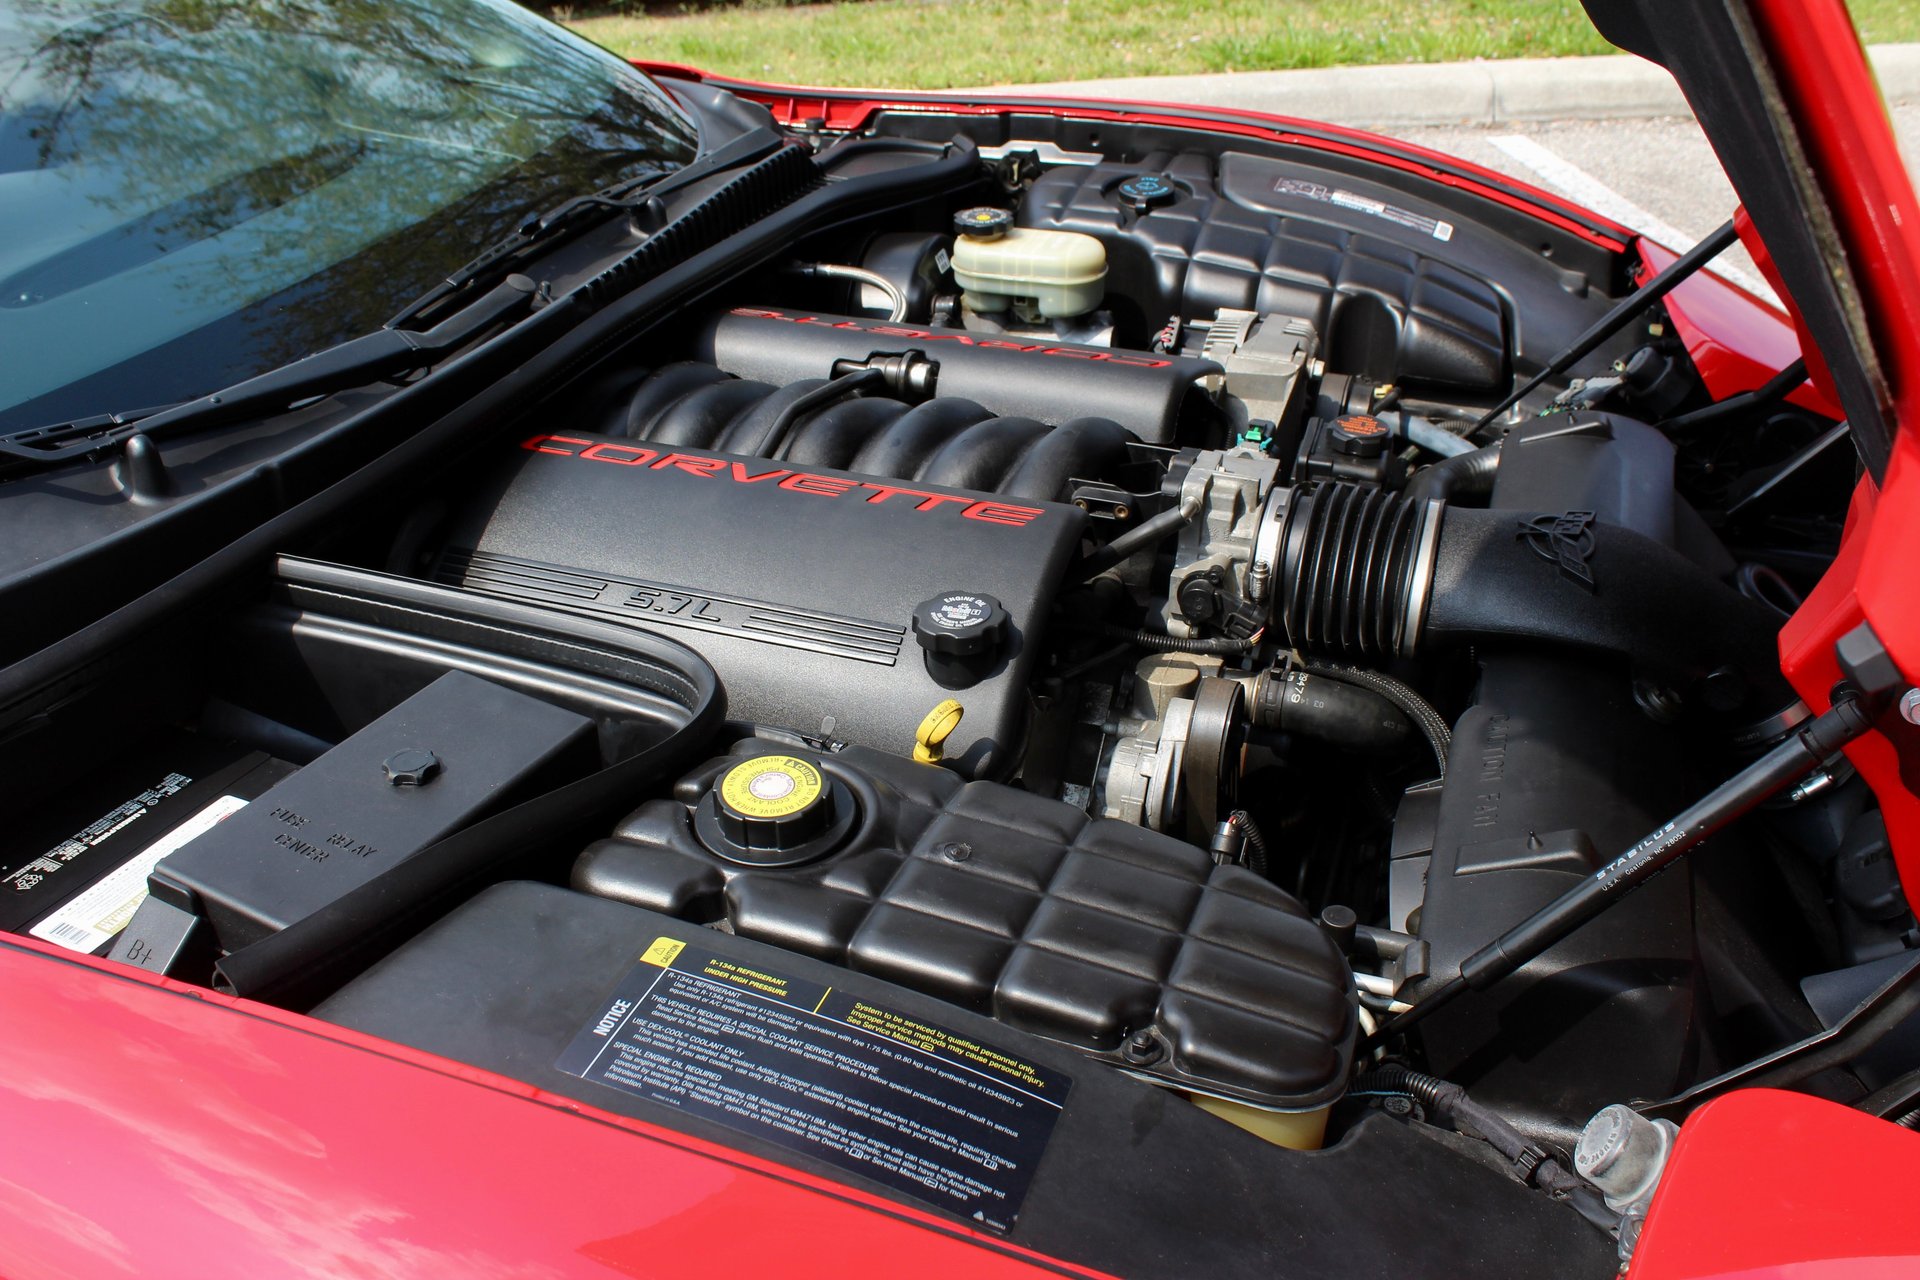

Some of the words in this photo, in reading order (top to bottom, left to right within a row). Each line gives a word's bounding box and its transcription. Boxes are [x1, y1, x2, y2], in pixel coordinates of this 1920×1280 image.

[520, 434, 1046, 526] CORVETTE
[623, 588, 721, 622] 5.7L
[795, 763, 817, 785] CAUTION
[270, 807, 311, 830] FUSE
[326, 833, 377, 858] RELAY
[274, 834, 329, 863] CENTER
[1596, 822, 1675, 880] STABILUS
[1601, 876, 1621, 892] U.S.A.
[1625, 855, 1654, 876] Gastonia,
[1654, 846, 1665, 856] NC
[1665, 830, 1687, 848] 28052
[127, 939, 152, 965] B+
[661, 944, 680, 964] CAUTION
[667, 972, 694, 984] R-134a
[693, 980, 742, 998] REFRIGERANT
[704, 967, 730, 979] UNDER
[729, 974, 749, 985] HIGH
[748, 980, 787, 997] PRESSURE
[709, 959, 736, 971] R-134a
[736, 967, 787, 986] REFRIGERANT
[593, 998, 632, 1037] NOTICE
[651, 1010, 678, 1022] damage
[685, 1020, 697, 1028] the
[669, 987, 702, 1001] equivalent
[708, 999, 722, 1007] A/C
[721, 1003, 745, 1014] system
[632, 1017, 648, 1027] USE
[689, 1035, 725, 1051] COOLANT
[724, 1046, 745, 1057] ONLY
[651, 994, 668, 1004] THIS
[667, 999, 697, 1013] VEHICLE
[696, 1008, 732, 1024] REQUIRES
[738, 1021, 767, 1036] SPECIAL
[769, 1031, 804, 1047] COOLANT
[803, 1043, 835, 1058] SERVICE
[835, 1053, 879, 1074] PROCEDURE
[673, 981, 686, 989] Use
[686, 985, 701, 994] only
[700, 989, 724, 1001] R-134a
[724, 997, 758, 1011] refrigerant
[803, 1022, 837, 1037] equivalent
[837, 1034, 852, 1042] with
[852, 1039, 865, 1047] dye
[924, 1065, 938, 1074] and
[937, 1070, 967, 1085] synthetic
[846, 1016, 862, 1026] See
[862, 1021, 891, 1036] Service
[891, 1031, 920, 1046] Manual
[850, 1009, 885, 1025] Improper
[885, 1022, 913, 1035] service
[913, 1032, 946, 1048] methods
[947, 1044, 965, 1055] may
[965, 1051, 988, 1064] cause
[988, 1060, 1022, 1077] personal
[1022, 1073, 1044, 1088] injury.
[855, 1002, 883, 1016] System
[883, 1012, 892, 1020] to
[892, 1015, 903, 1024] be
[904, 1020, 936, 1035] serviced
[936, 1031, 947, 1040] by
[947, 1036, 980, 1052] qualified
[980, 1049, 1018, 1067] personnel
[1018, 1064, 1035, 1077] only.
[613, 1041, 642, 1056] SPECIAL
[643, 1051, 672, 1065] ENGINE
[671, 1060, 683, 1069] OIL
[684, 1064, 722, 1081] REQUIRED
[655, 1003, 674, 1013] Read
[673, 1009, 697, 1020] Service
[697, 1016, 722, 1028] Manual
[735, 1028, 757, 1040] before
[757, 1035, 774, 1045] flush
[774, 1042, 788, 1050] and
[787, 1046, 804, 1055] refill
[836, 1062, 859, 1075] Failure
[859, 1070, 867, 1078] to
[867, 1073, 889, 1085] follow
[888, 1082, 913, 1094] special
[912, 1091, 947, 1108] procedure
[947, 1104, 967, 1116] could
[966, 1112, 986, 1124] result
[986, 1119, 994, 1127] in
[994, 1123, 1019, 1138] serious
[638, 1026, 652, 1036] This
[652, 1032, 676, 1043] vehicle
[675, 1039, 689, 1047] has
[688, 1044, 720, 1057] extended
[719, 1052, 730, 1061] life
[756, 1065, 780, 1079] Adding
[780, 1073, 811, 1088] improper
[811, 1084, 844, 1101] (silicated)
[844, 1096, 870, 1110] coolant
[870, 1106, 883, 1114] will
[882, 1111, 908, 1125] shorten
[909, 1120, 921, 1129] the
[921, 1126, 947, 1140] coolant
[960, 1142, 991, 1160] requiring
[991, 1155, 1017, 1169] change
[619, 1051, 634, 1061] This
[633, 1057, 657, 1068] engine
[656, 1064, 684, 1077] requires
[684, 1073, 709, 1085] special
[708, 1081, 719, 1089] oil
[718, 1085, 746, 1099] meeting
[746, 1093, 759, 1102] GM
[759, 1098, 790, 1113] Standard
[828, 1122, 848, 1135] Using
[848, 1130, 867, 1141] other
[867, 1138, 891, 1151] engine
[891, 1147, 904, 1156] oils
[904, 1152, 918, 1162] can
[918, 1158, 940, 1171] cause
[940, 1167, 964, 1181] engine
[964, 1177, 993, 1193] damage
[993, 1189, 1006, 1199] not
